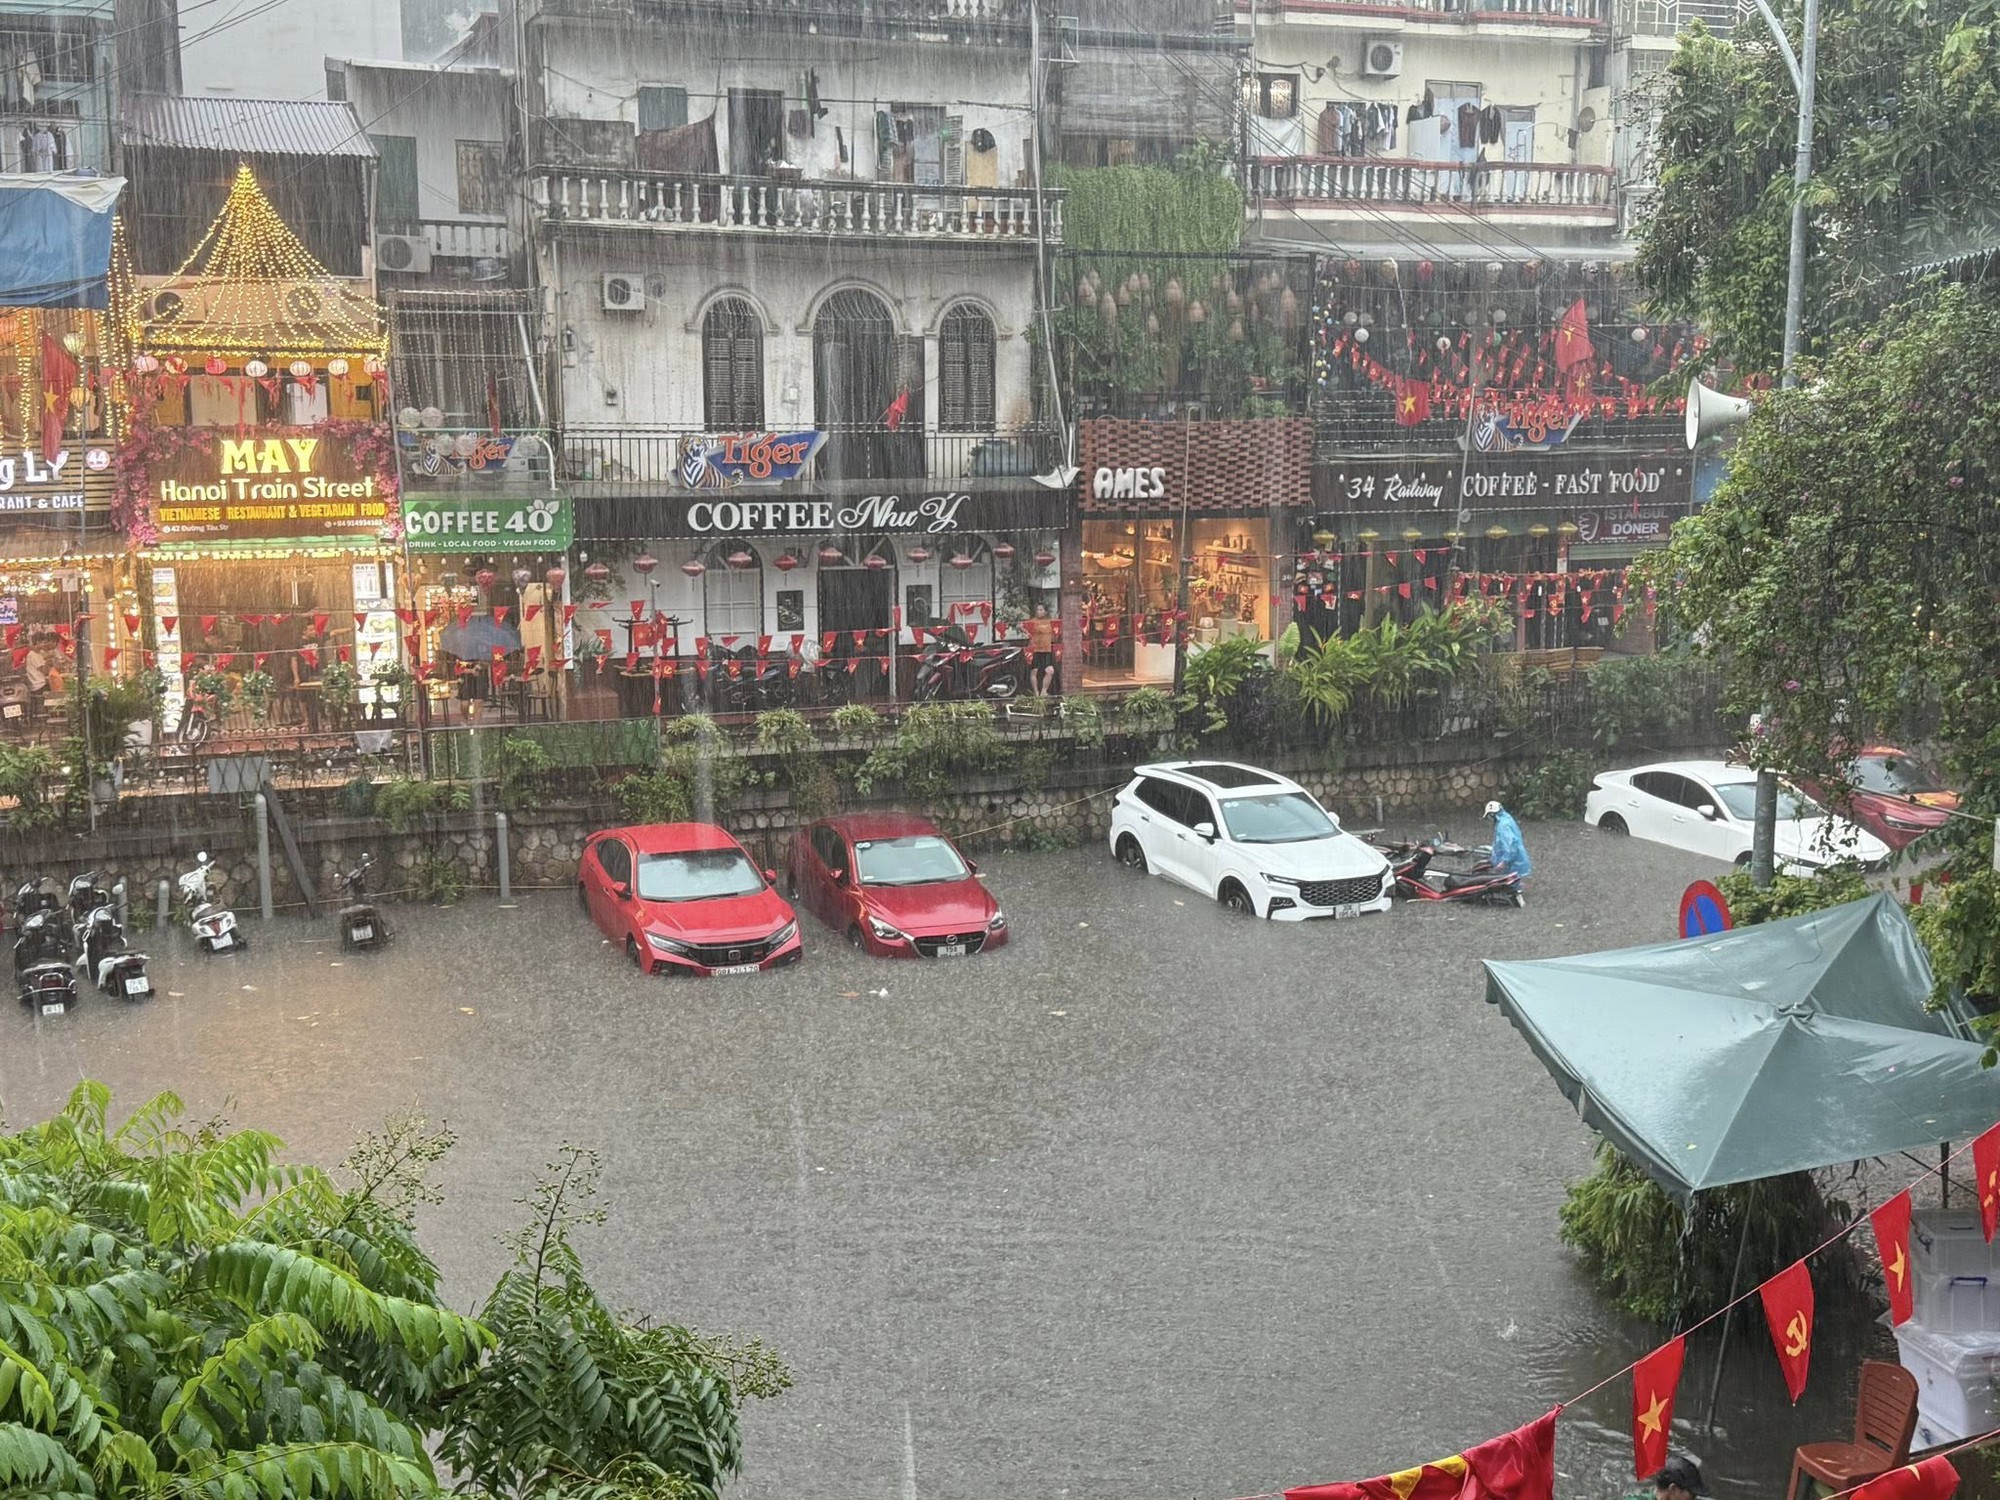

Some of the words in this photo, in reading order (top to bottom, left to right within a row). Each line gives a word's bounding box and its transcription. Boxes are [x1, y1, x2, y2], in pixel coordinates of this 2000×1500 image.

[221, 438, 319, 474] MAY
[719, 430, 809, 478] Tiger
[161, 479, 227, 501] Hanoi
[231, 478, 298, 500] Train
[303, 475, 374, 498] Street
[1093, 467, 1166, 499] AMES
[1347, 476, 1375, 499] 34
[1383, 475, 1443, 507] Railway
[1463, 475, 1538, 497] COFFEE
[1554, 473, 1602, 494] FAST
[1609, 472, 1660, 493] FOOD
[160, 507, 220, 521] VIETNAMESE
[227, 505, 286, 519] RESTAURANT
[288, 505, 298, 518] &
[299, 503, 355, 517] VEGETARIAN
[361, 502, 385, 516] FOOD
[405, 511, 499, 534] COFFEE
[505, 509, 553, 533] 40
[686, 502, 834, 532] COFFEE
[837, 495, 920, 529] Như
[443, 540, 471, 548] LOCAL
[472, 540, 497, 548] FOOD
